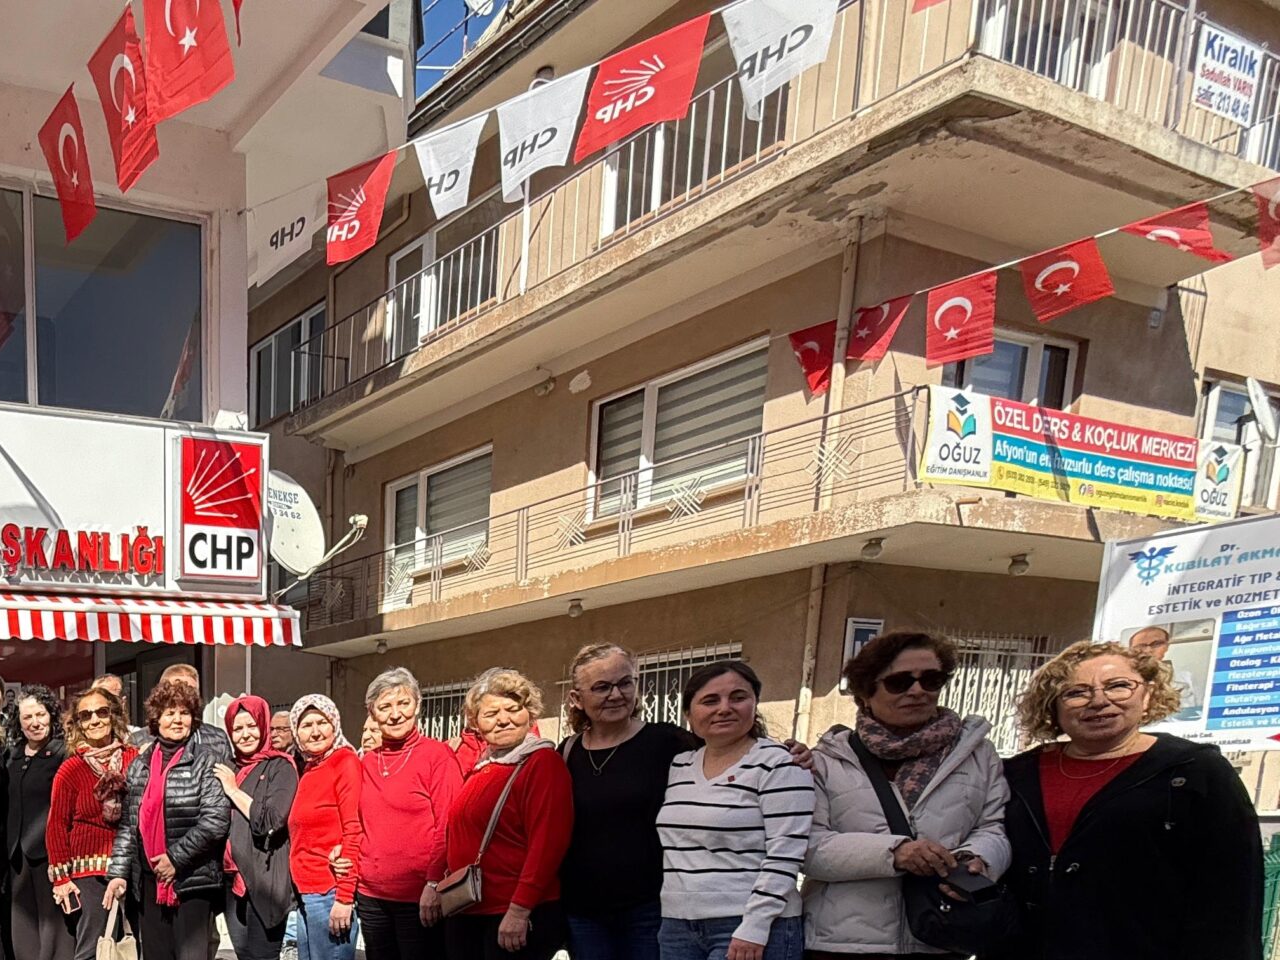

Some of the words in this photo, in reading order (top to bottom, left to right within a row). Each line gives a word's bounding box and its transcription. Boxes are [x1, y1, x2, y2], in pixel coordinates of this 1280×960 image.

[1204, 31, 1258, 78] Kiralık
[994, 401, 1031, 431] ÖZEL
[1033, 413, 1070, 440] DERS
[1071, 422, 1082, 443] &
[1084, 424, 1140, 453] KOÇLUK
[1141, 435, 1197, 463] MERKEZİ
[939, 441, 981, 464] OĞUZ
[994, 439, 1038, 465] Afyon'un
[1094, 460, 1116, 479] ders
[1117, 466, 1155, 486] çalışma
[1200, 488, 1228, 507] OĞUZ
[188, 532, 255, 571] CHP
[1220, 543, 1240, 553] Dr.
[1164, 555, 1233, 574] KUBİLAY
[1167, 573, 1246, 596] İNTEGRATİF
[1250, 571, 1273, 585] TIP
[1148, 598, 1203, 616] ESTETİK
[1206, 599, 1223, 608] ve
[1225, 588, 1280, 607] KOZMET
